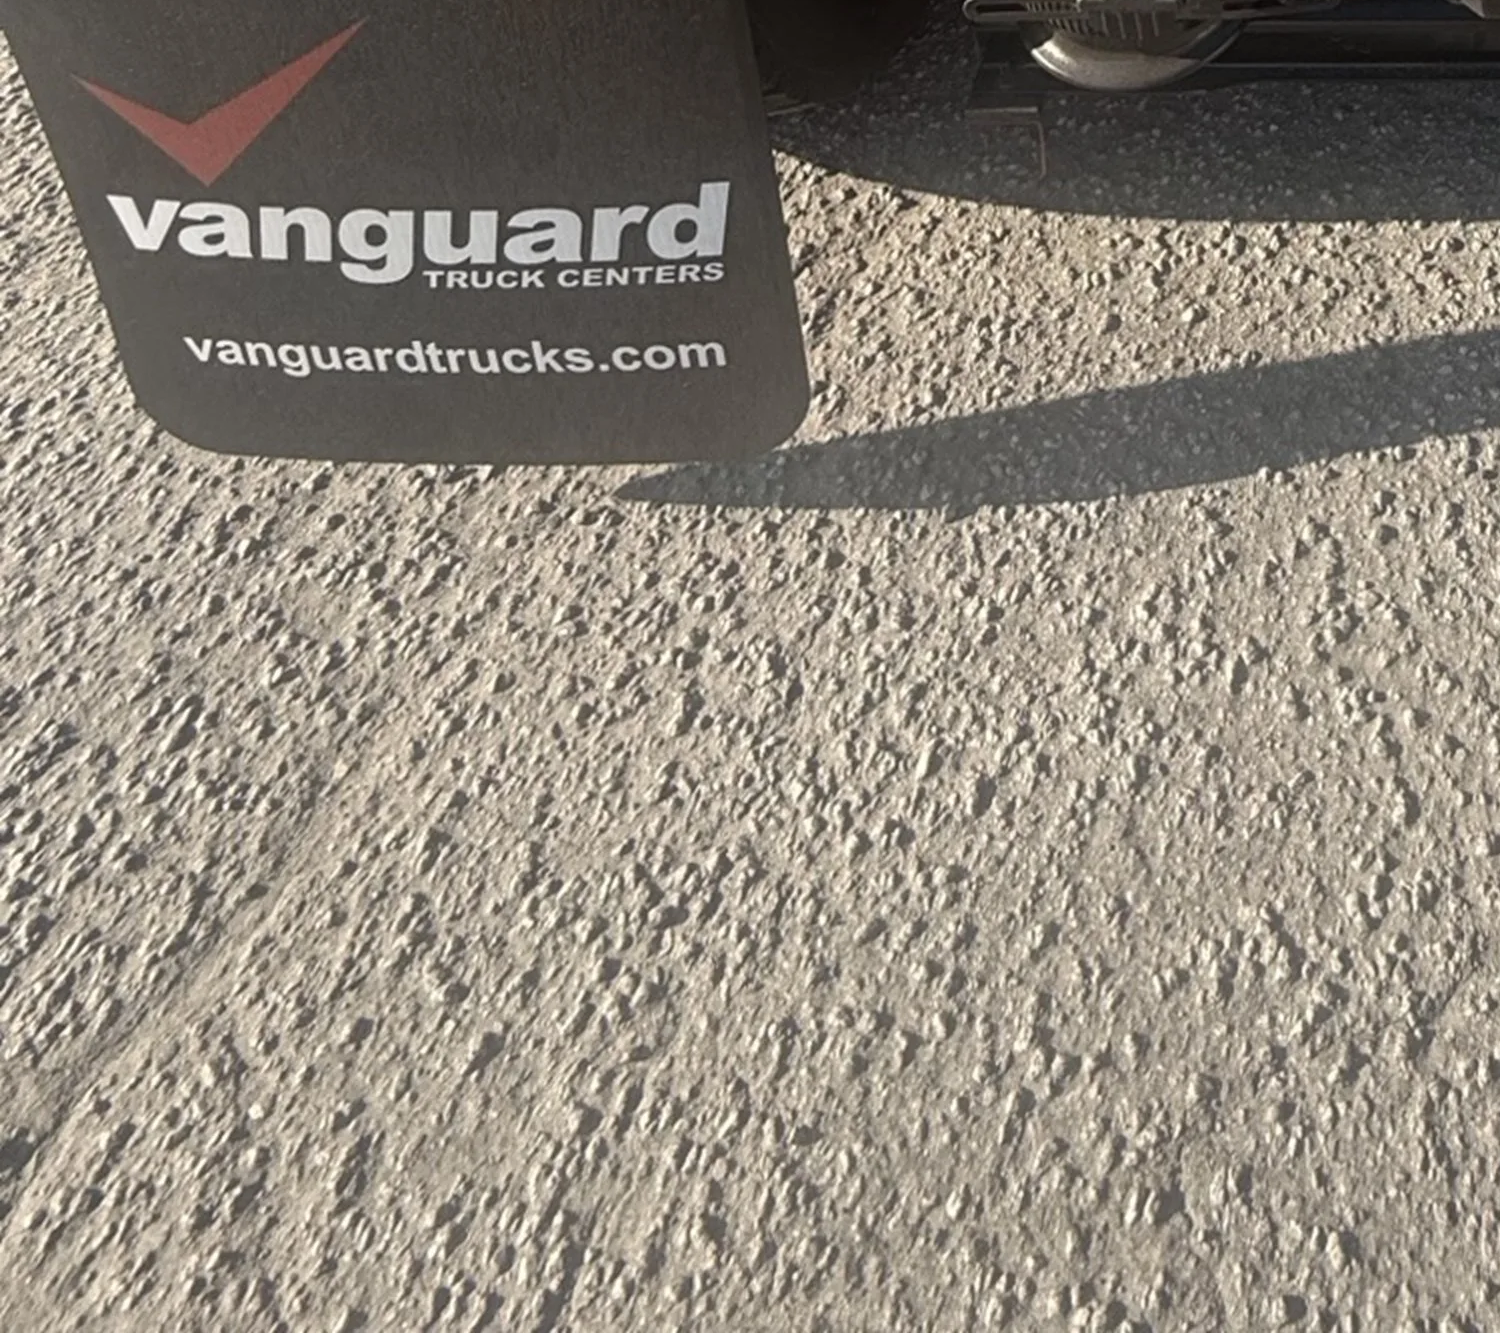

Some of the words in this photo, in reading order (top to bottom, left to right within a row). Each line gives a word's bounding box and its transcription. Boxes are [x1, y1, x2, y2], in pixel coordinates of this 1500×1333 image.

[106, 182, 730, 283] vanguard
[423, 270, 545, 289] TRUCK
[557, 263, 724, 288] CENTERS
[184, 337, 727, 377] vanguardtrucks.com
